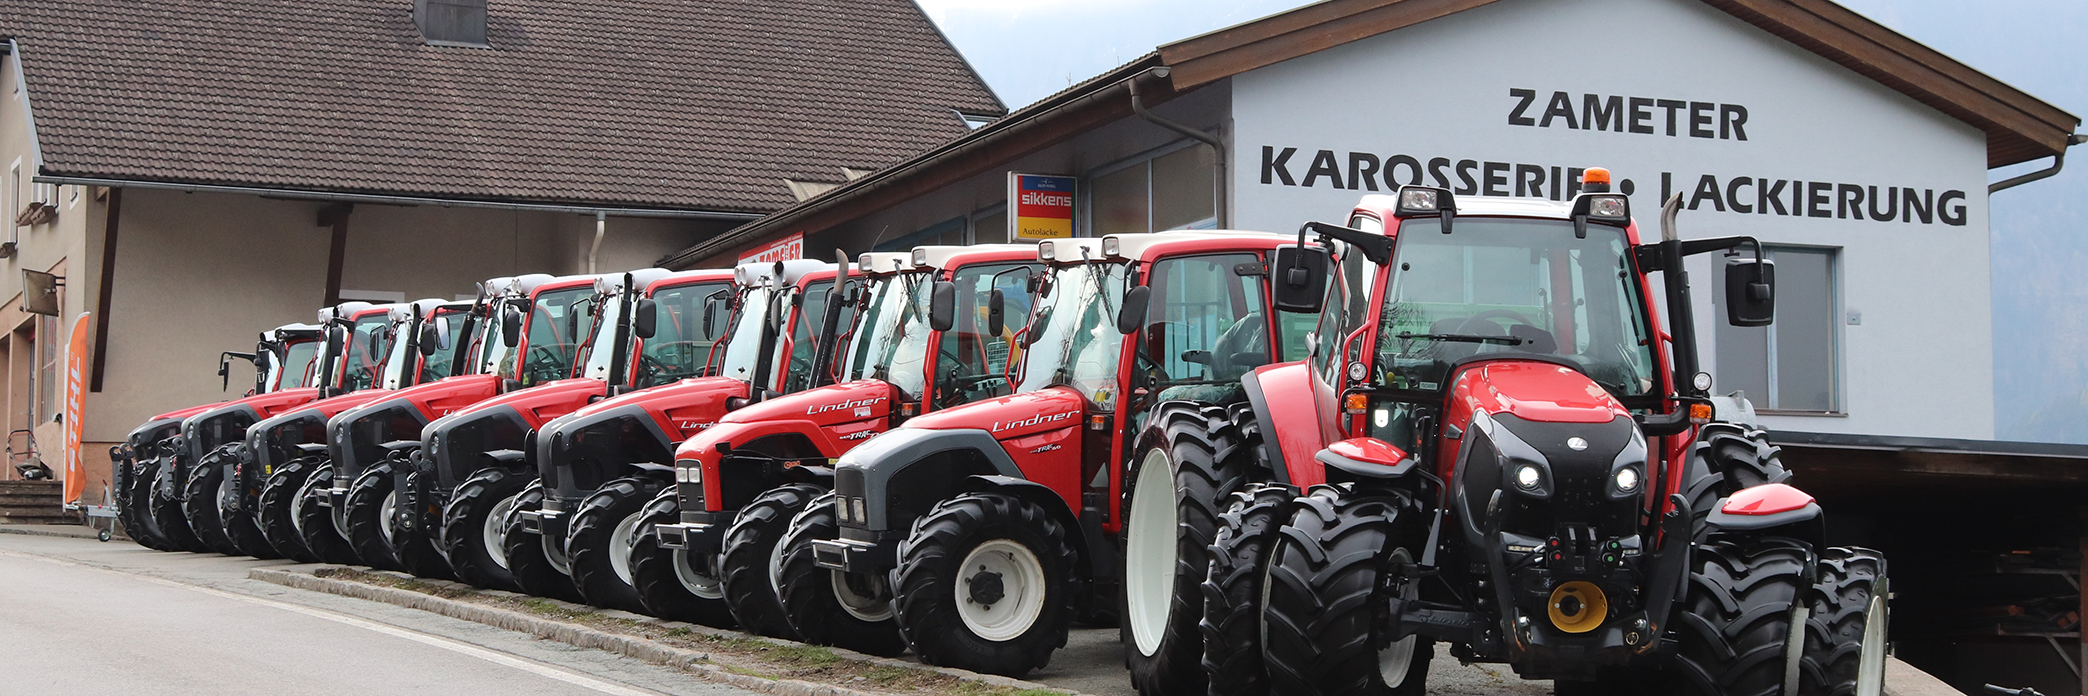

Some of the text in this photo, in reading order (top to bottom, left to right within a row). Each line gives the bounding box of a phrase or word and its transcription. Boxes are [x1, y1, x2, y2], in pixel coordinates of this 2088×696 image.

[1508, 88, 1748, 141] ZAMETER
[1022, 192, 1071, 207] sikkens
[1661, 172, 1967, 226] LACKIERUNG
[1023, 228, 1058, 236] Autolacke
[68, 356, 80, 472] STIHL
[806, 397, 887, 415] Lindner
[680, 420, 715, 429] Lind
[992, 410, 1080, 432] Lindner
